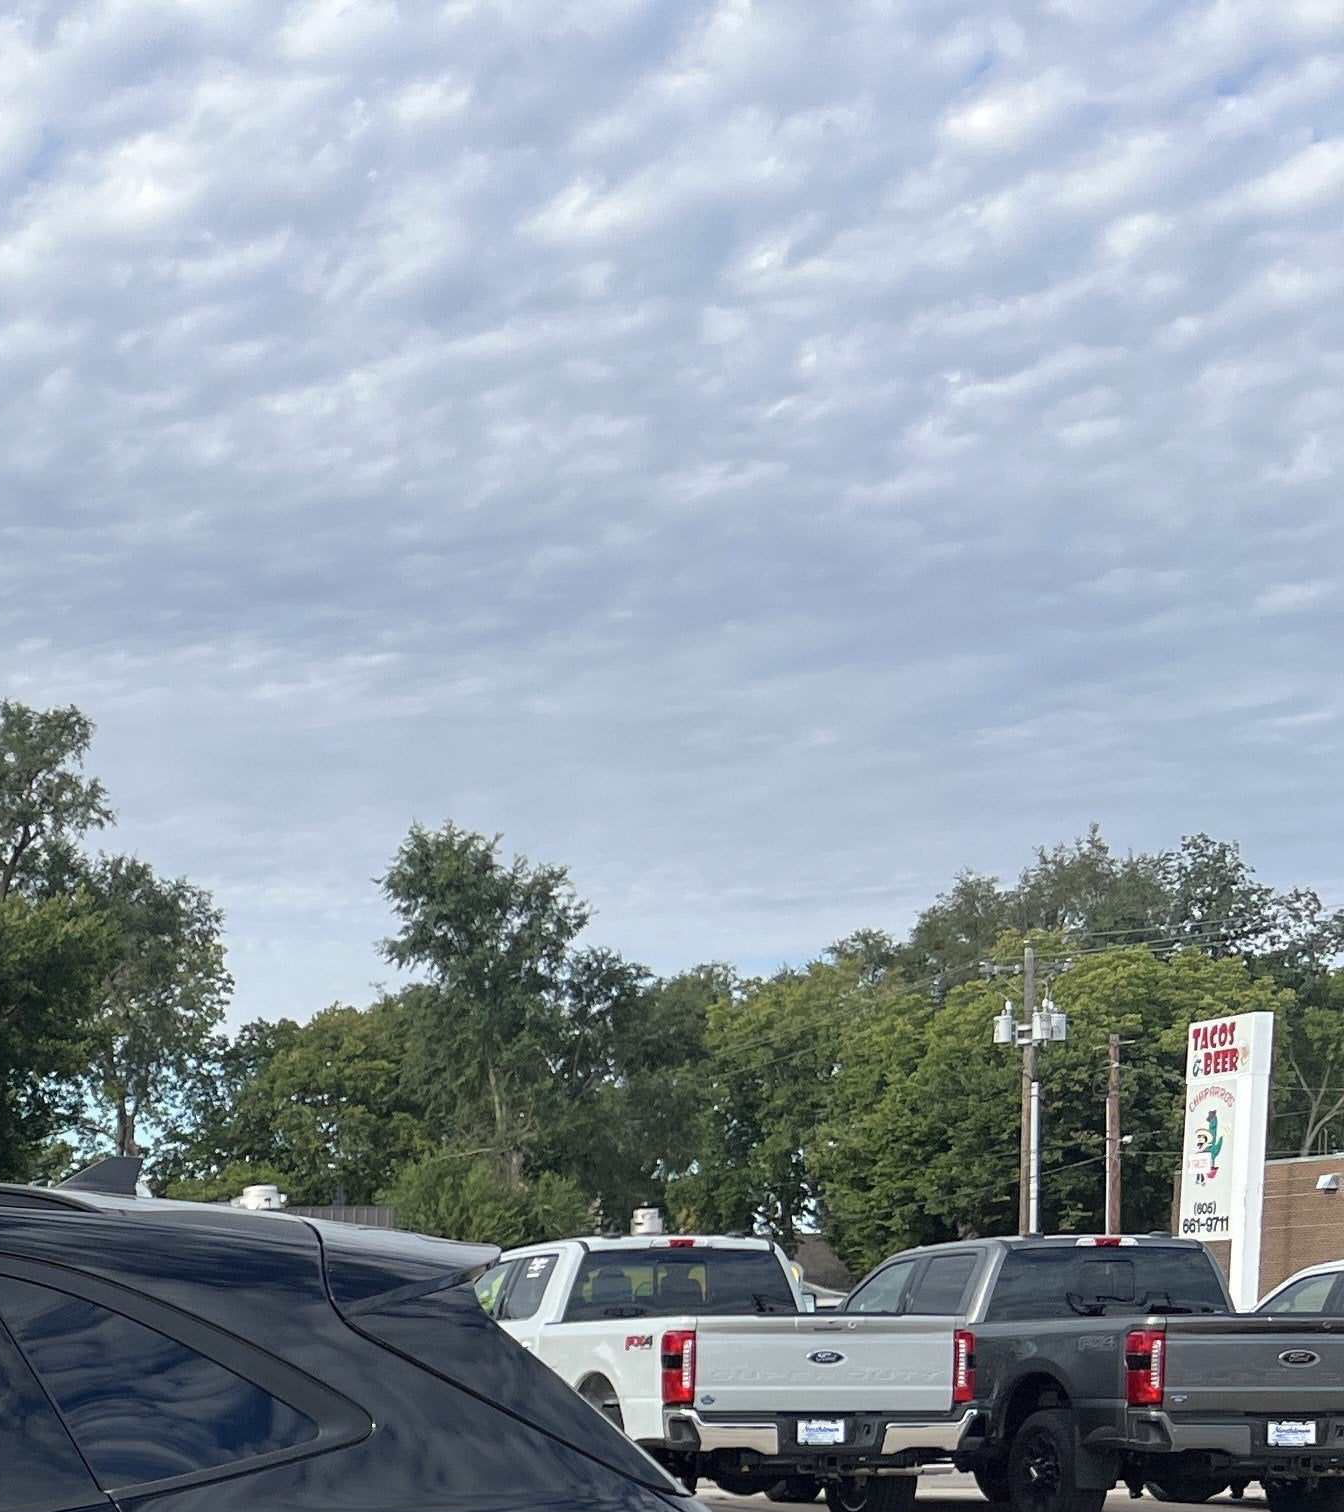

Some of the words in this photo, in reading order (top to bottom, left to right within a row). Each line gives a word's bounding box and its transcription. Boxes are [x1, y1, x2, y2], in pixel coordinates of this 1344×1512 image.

[1192, 1021, 1236, 1051] TACOS
[1203, 1047, 1238, 1076] BEER
[1194, 1201, 1217, 1216] (605)
[1183, 1216, 1229, 1234] 661-9711
